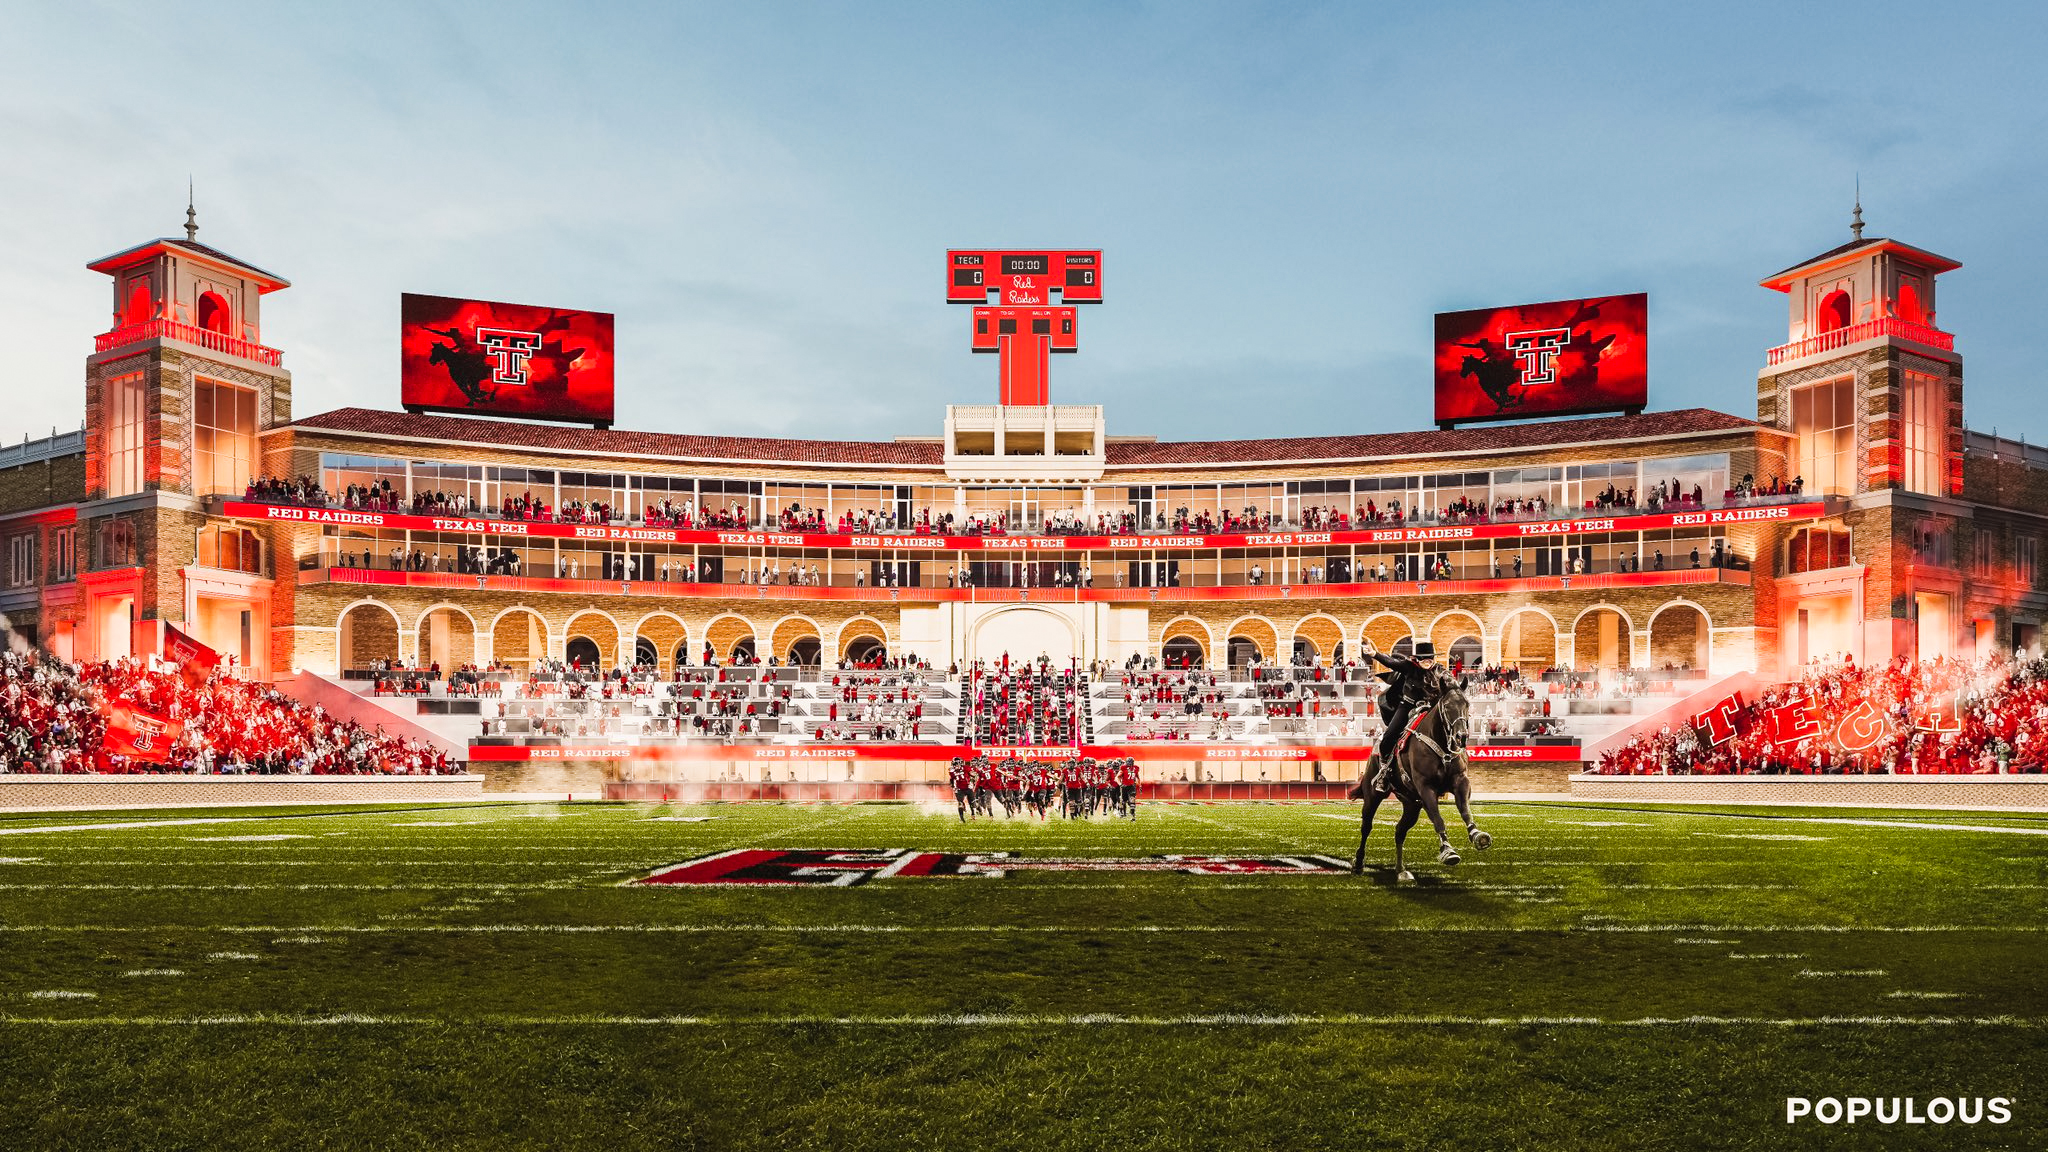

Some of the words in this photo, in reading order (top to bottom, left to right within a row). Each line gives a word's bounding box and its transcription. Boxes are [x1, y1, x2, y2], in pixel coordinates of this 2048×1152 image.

[958, 256, 980, 264] TECH
[1011, 260, 1040, 270] 00:00
[973, 271, 982, 284] 0
[1013, 275, 1036, 289] Red
[1084, 271, 1093, 284] 0
[1008, 290, 1040, 303] Raiders
[268, 508, 303, 519] RED
[308, 510, 384, 525] RAIDERS
[1672, 514, 1706, 525] RED
[1711, 507, 1789, 523] RAIDERS
[433, 519, 485, 531] TEXAS
[489, 522, 528, 534] TECH
[1519, 522, 1571, 534] TEXAS
[1574, 519, 1615, 531] TECH
[575, 527, 606, 537] RED
[610, 529, 676, 541] RAIDERS
[717, 534, 765, 544] TEXAS
[769, 535, 804, 545] TECH
[1245, 534, 1292, 545] TEXAS
[1295, 533, 1331, 543] TECH
[1373, 531, 1402, 541] RED
[1406, 528, 1473, 539] RAIDERS
[851, 537, 880, 547] RED
[883, 538, 945, 548] RAIDERS
[982, 539, 1028, 548] TEXAS
[1030, 539, 1065, 548] TECH
[1110, 538, 1138, 548] RED
[1141, 537, 1204, 547] RAIDERS
[530, 749, 560, 758] RED
[563, 749, 631, 758] RAIDERS
[756, 749, 786, 758] RED
[789, 749, 856, 758] RAIDERS
[980, 749, 1011, 758] RED
[1014, 749, 1081, 758] RAIDERS
[1206, 749, 1237, 758] RED
[1240, 749, 1307, 758] RAIDERS
[1467, 749, 1533, 758] RAIDERS
